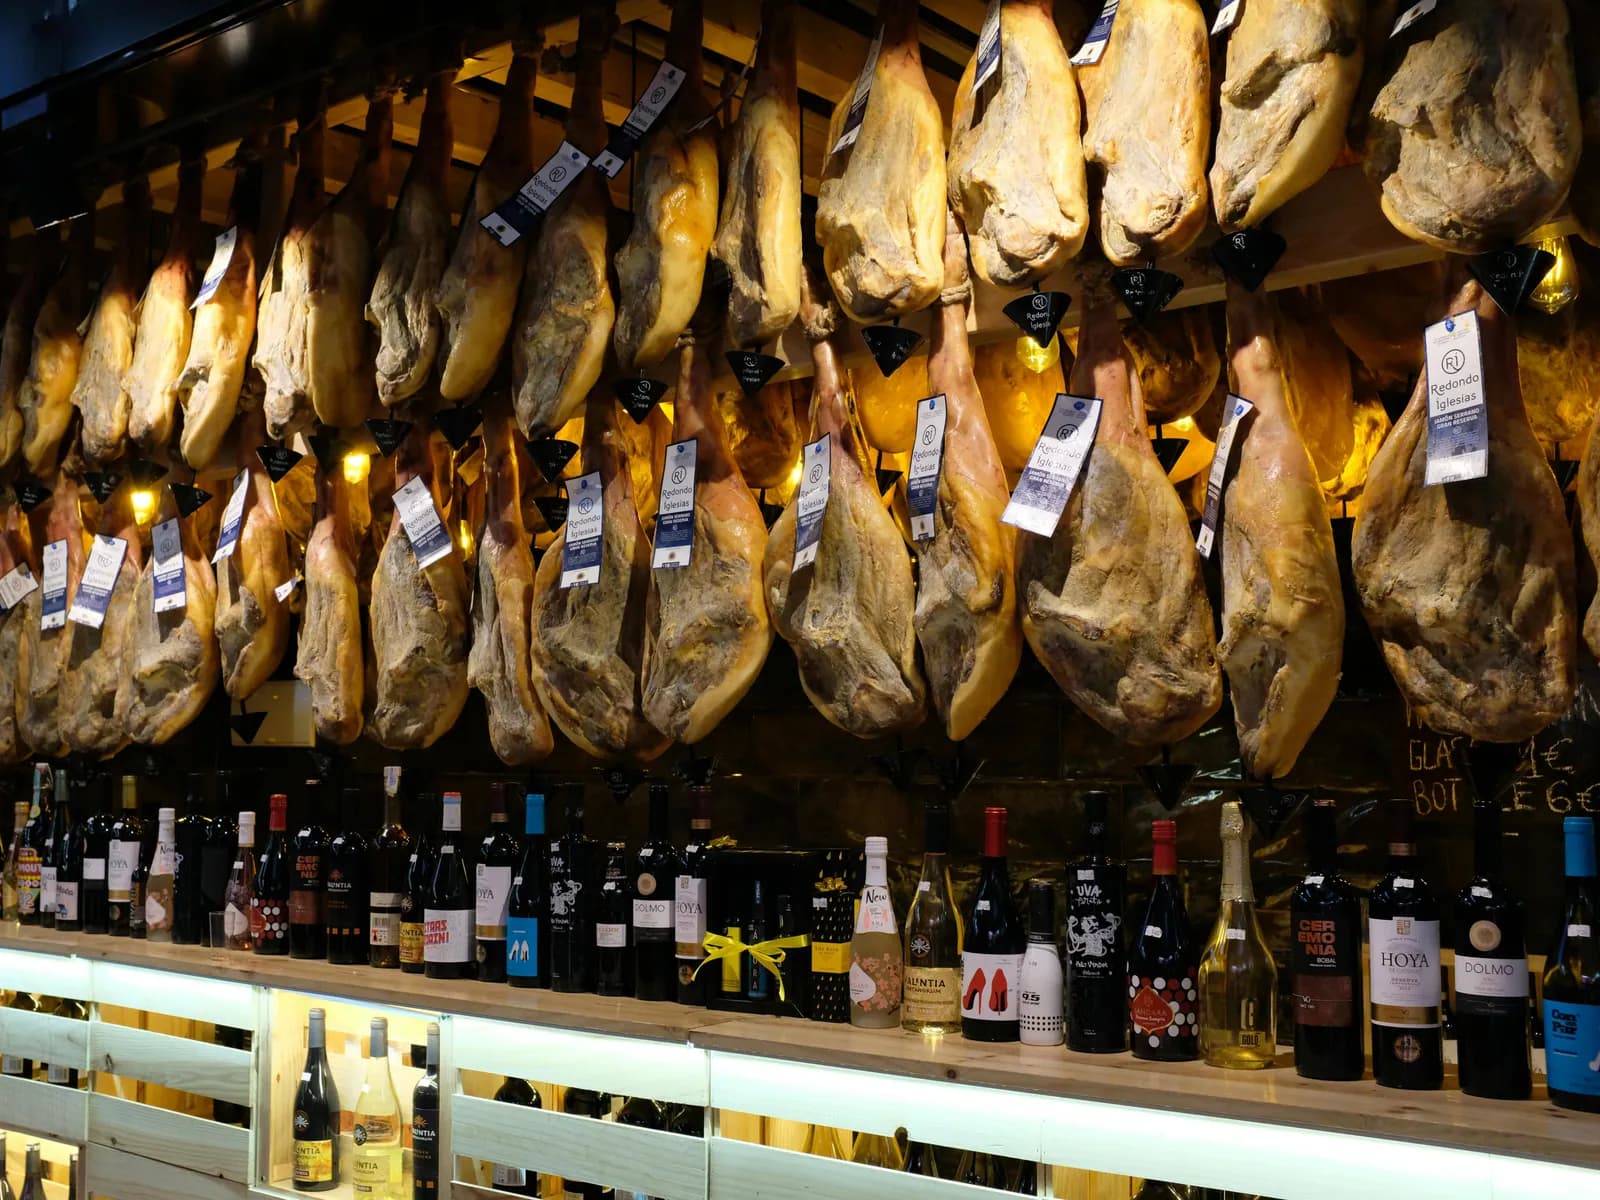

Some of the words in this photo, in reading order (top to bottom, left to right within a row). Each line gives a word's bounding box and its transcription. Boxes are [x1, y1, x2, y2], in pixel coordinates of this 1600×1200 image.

[1430, 373, 1480, 396] Redondo
[1435, 392, 1477, 412] Iglesias
[1036, 454, 1073, 473] Igleas
[662, 486, 693, 500] Redondo
[663, 499, 690, 513] Iglesias
[568, 514, 601, 529] Redondo
[571, 526, 598, 539] Iglesias
[865, 885, 887, 905] New
[1076, 883, 1103, 898] UVA
[1298, 919, 1337, 932] CER
[1297, 931, 1337, 944] EMO
[1304, 943, 1337, 956] NIA
[1380, 951, 1430, 968] HOYA
[1464, 961, 1515, 976] DOLMO
[1022, 992, 1041, 1002] 9.5
